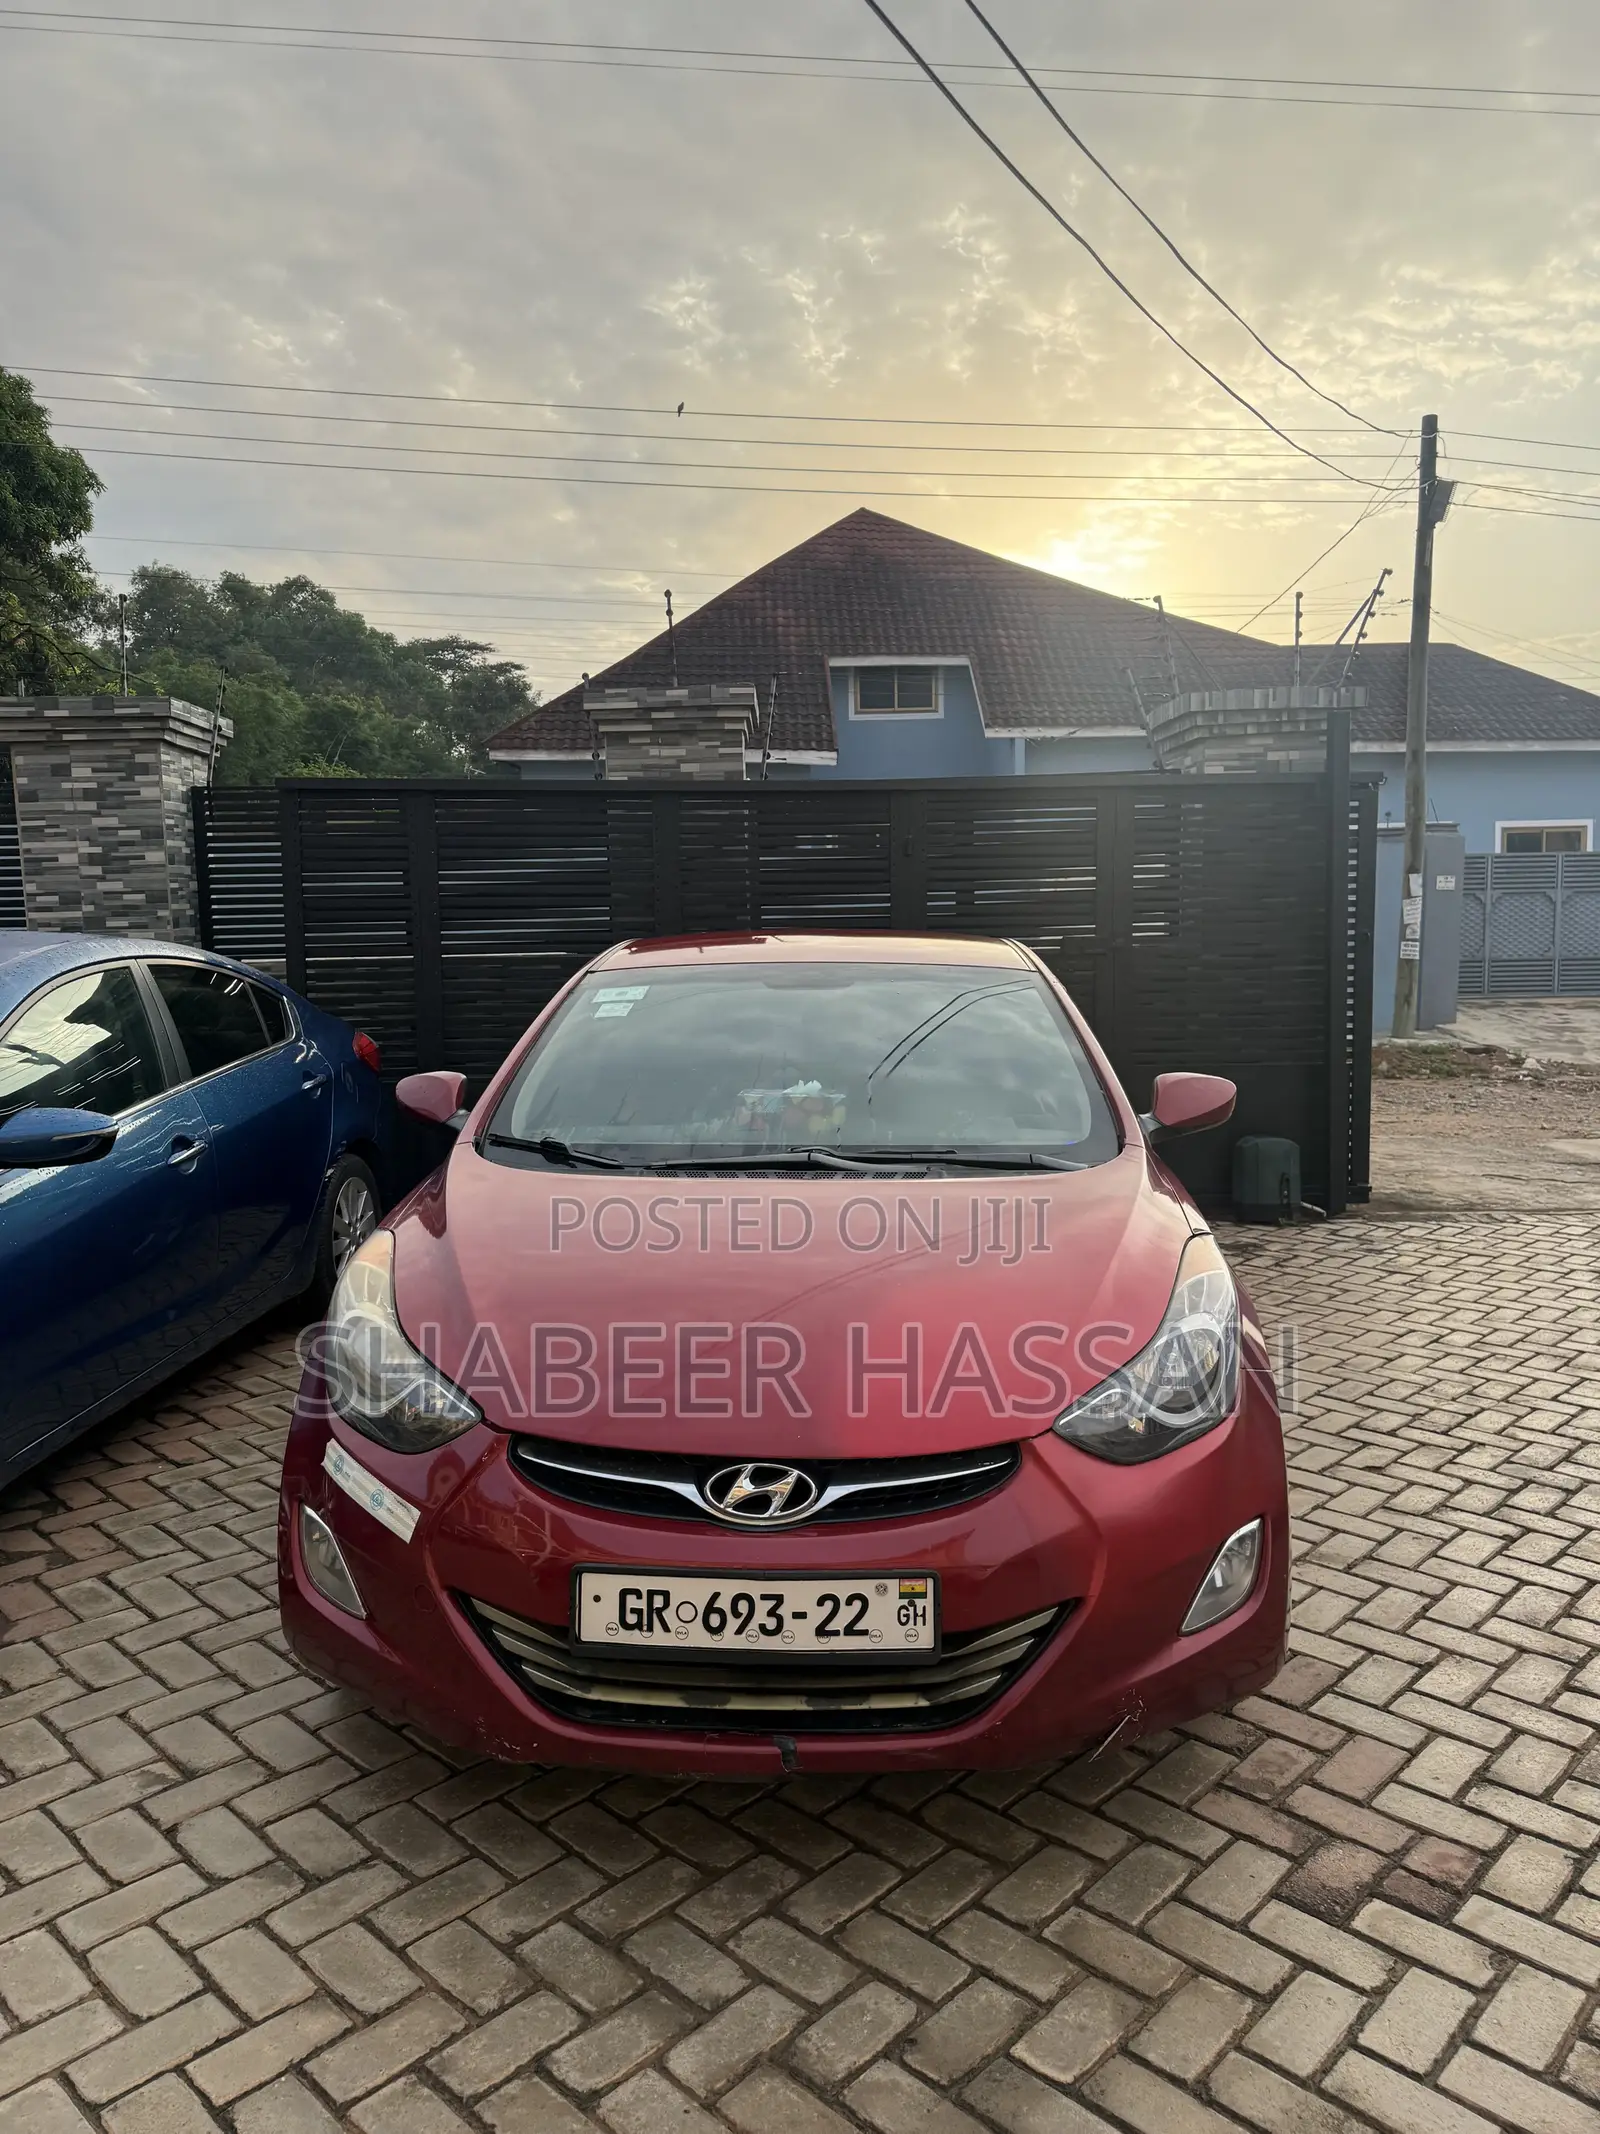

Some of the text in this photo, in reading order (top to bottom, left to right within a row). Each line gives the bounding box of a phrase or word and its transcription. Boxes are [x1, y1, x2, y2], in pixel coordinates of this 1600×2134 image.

[618, 1587, 870, 1637] GR 693-22
[897, 1604, 927, 1627] GH
